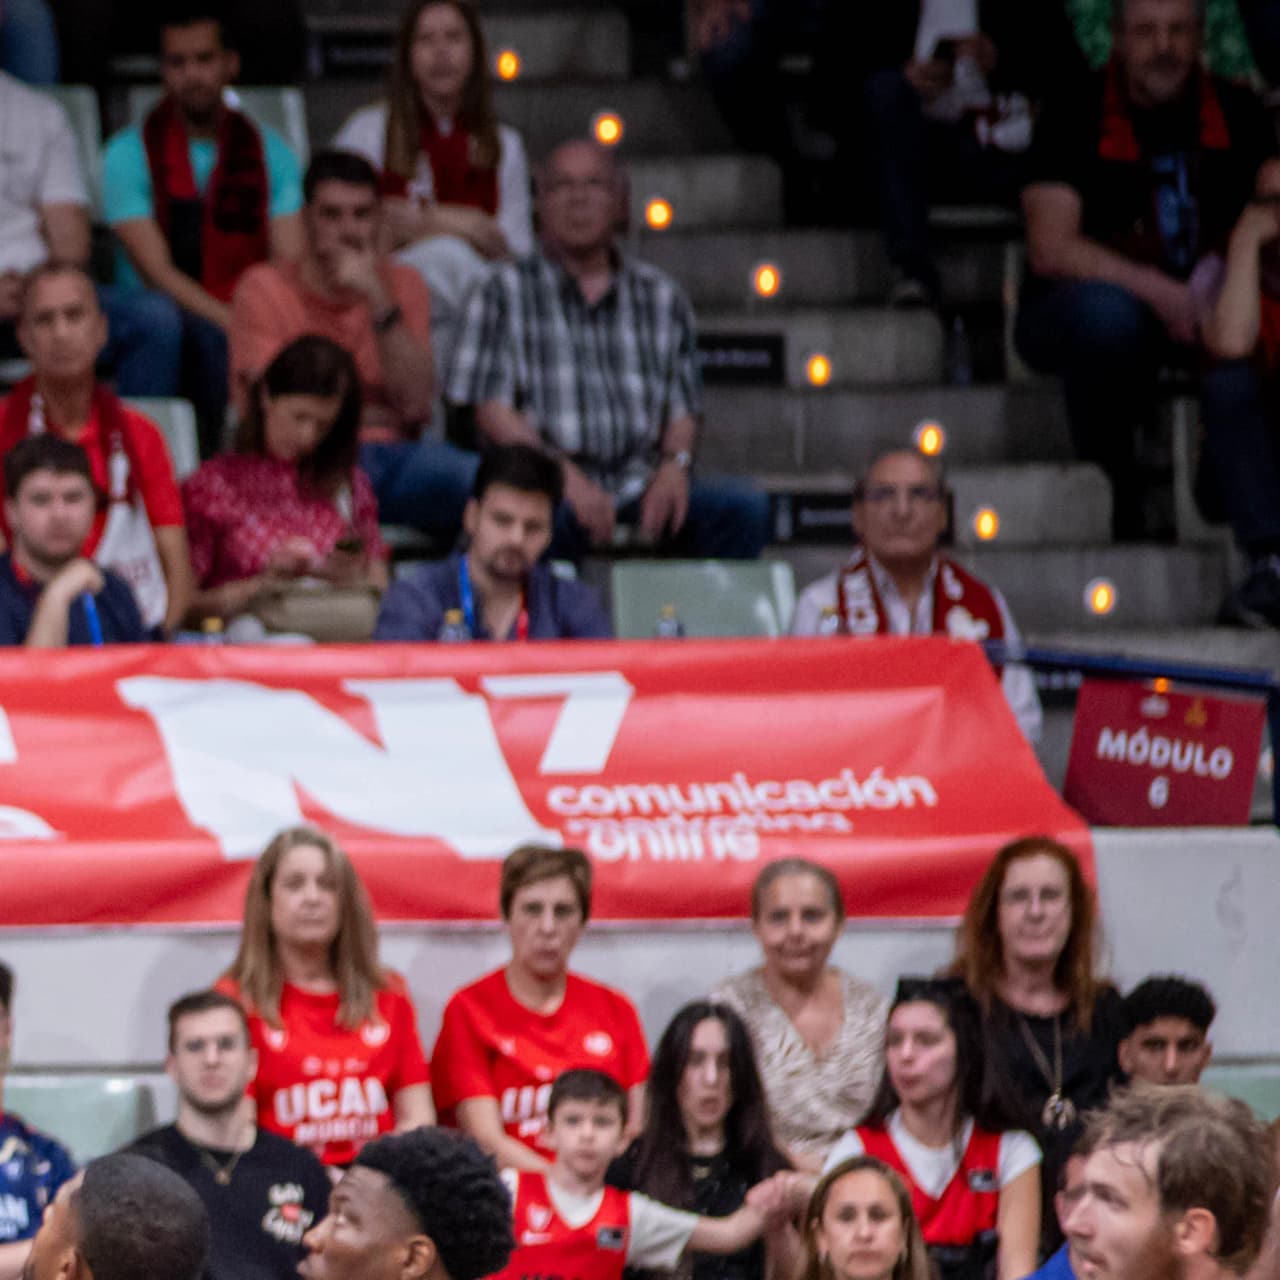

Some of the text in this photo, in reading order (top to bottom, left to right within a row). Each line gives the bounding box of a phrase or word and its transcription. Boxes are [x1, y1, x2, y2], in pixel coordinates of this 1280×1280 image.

[1096, 726, 1234, 780] MÓDULO
[545, 766, 939, 816] comunicación
[1147, 774, 1172, 811] 6
